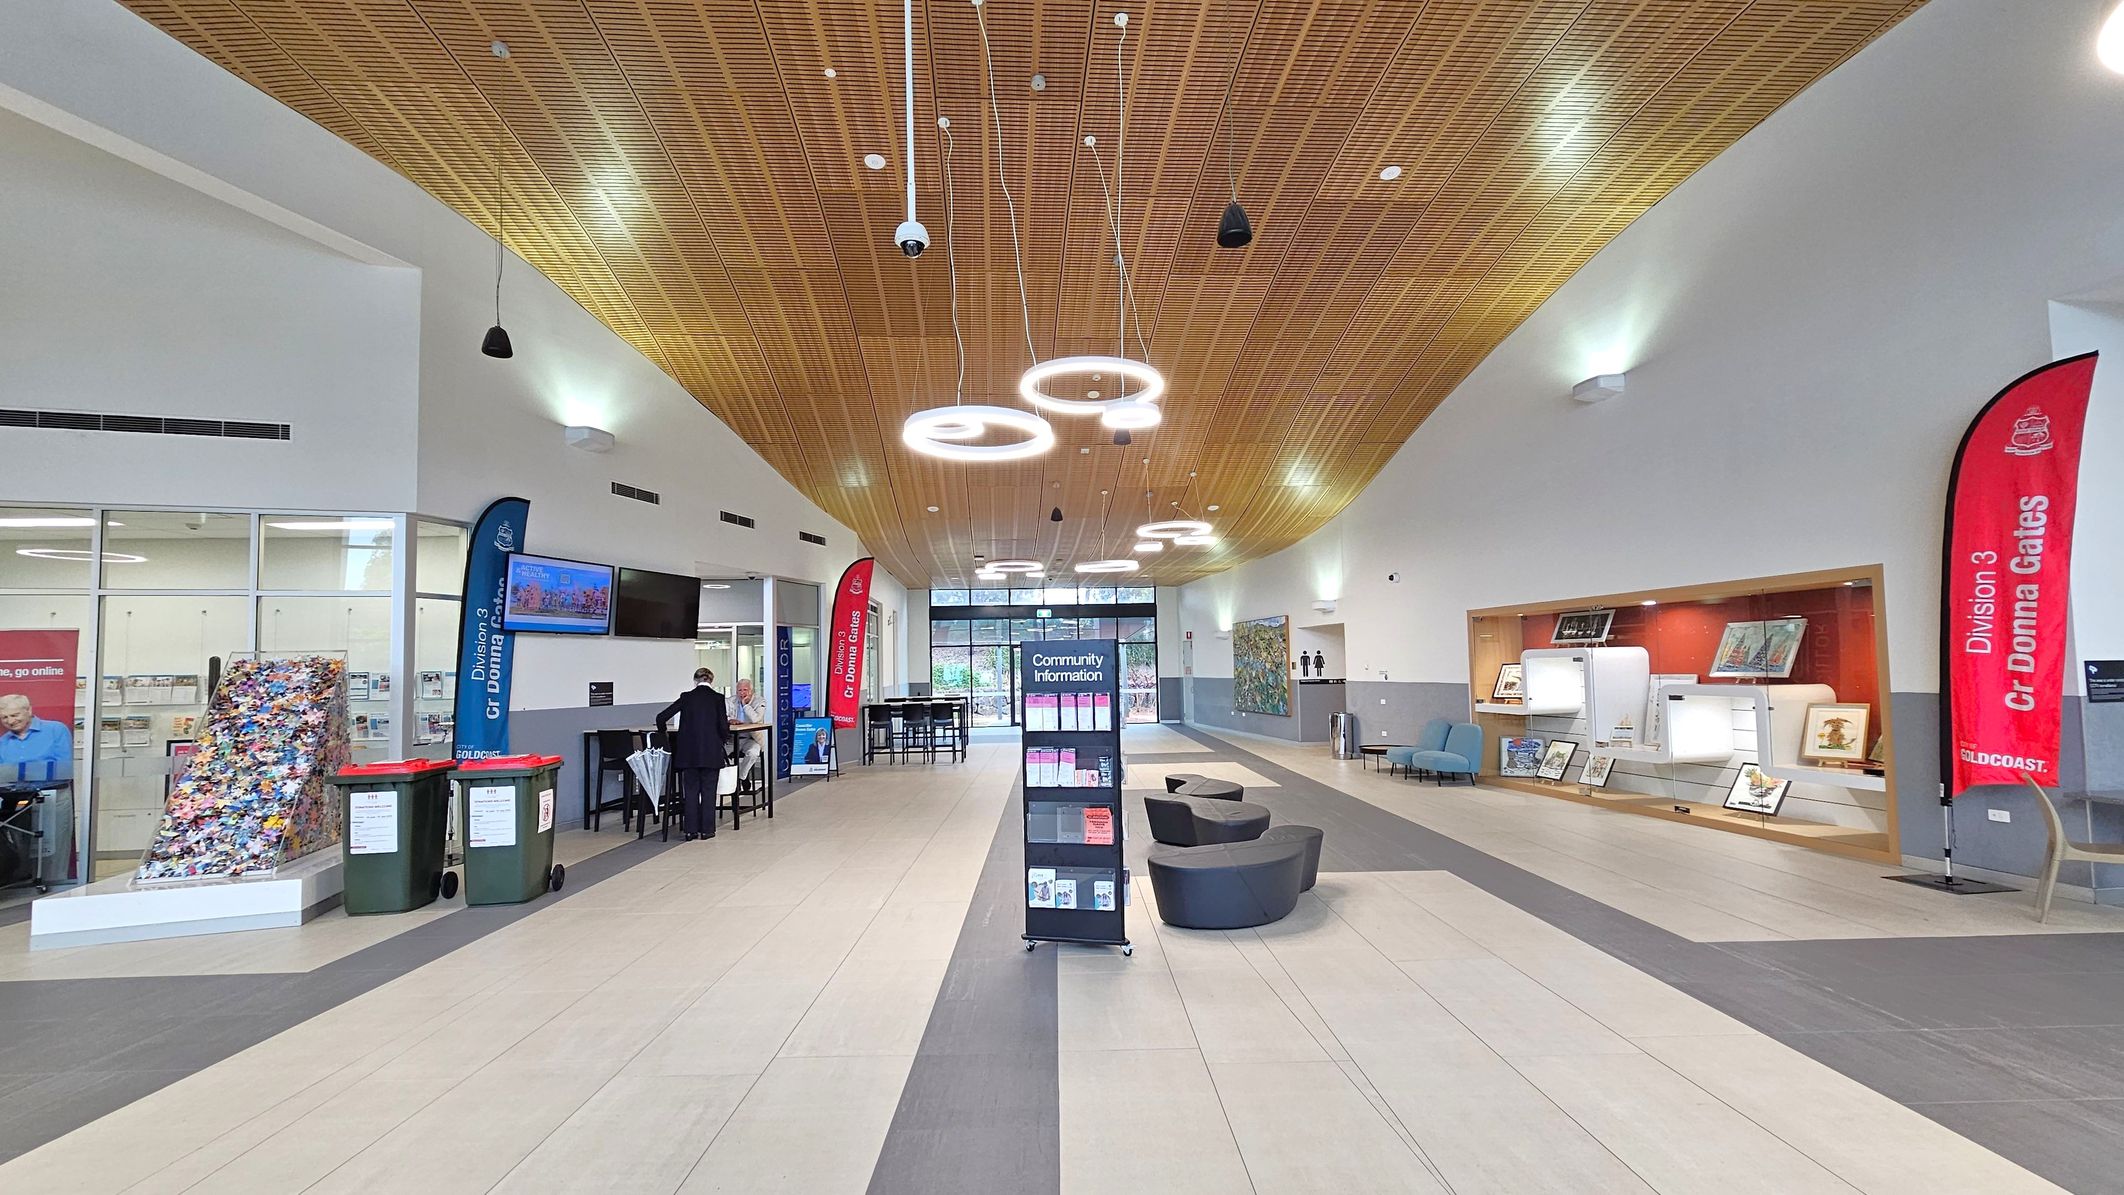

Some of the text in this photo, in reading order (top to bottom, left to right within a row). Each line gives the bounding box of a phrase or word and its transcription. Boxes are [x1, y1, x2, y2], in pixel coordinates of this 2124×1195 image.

[2010, 495, 2050, 575] Gates
[522, 570, 550, 579] HEALTHY
[1966, 550, 1998, 654] Division 3
[471, 608, 488, 681] Division 3
[2007, 583, 2040, 674] Donna
[15, 668, 29, 678] go
[32, 666, 64, 676] online
[486, 634, 504, 694] Donna
[834, 639, 846, 675] Division
[844, 610, 860, 698] Cr Donna Gates
[1032, 652, 1104, 668] Community
[1034, 669, 1103, 682] Information
[486, 698, 500, 720] Cr
[780, 638, 790, 772] COUNCILLOR
[2004, 680, 2036, 712] Cr
